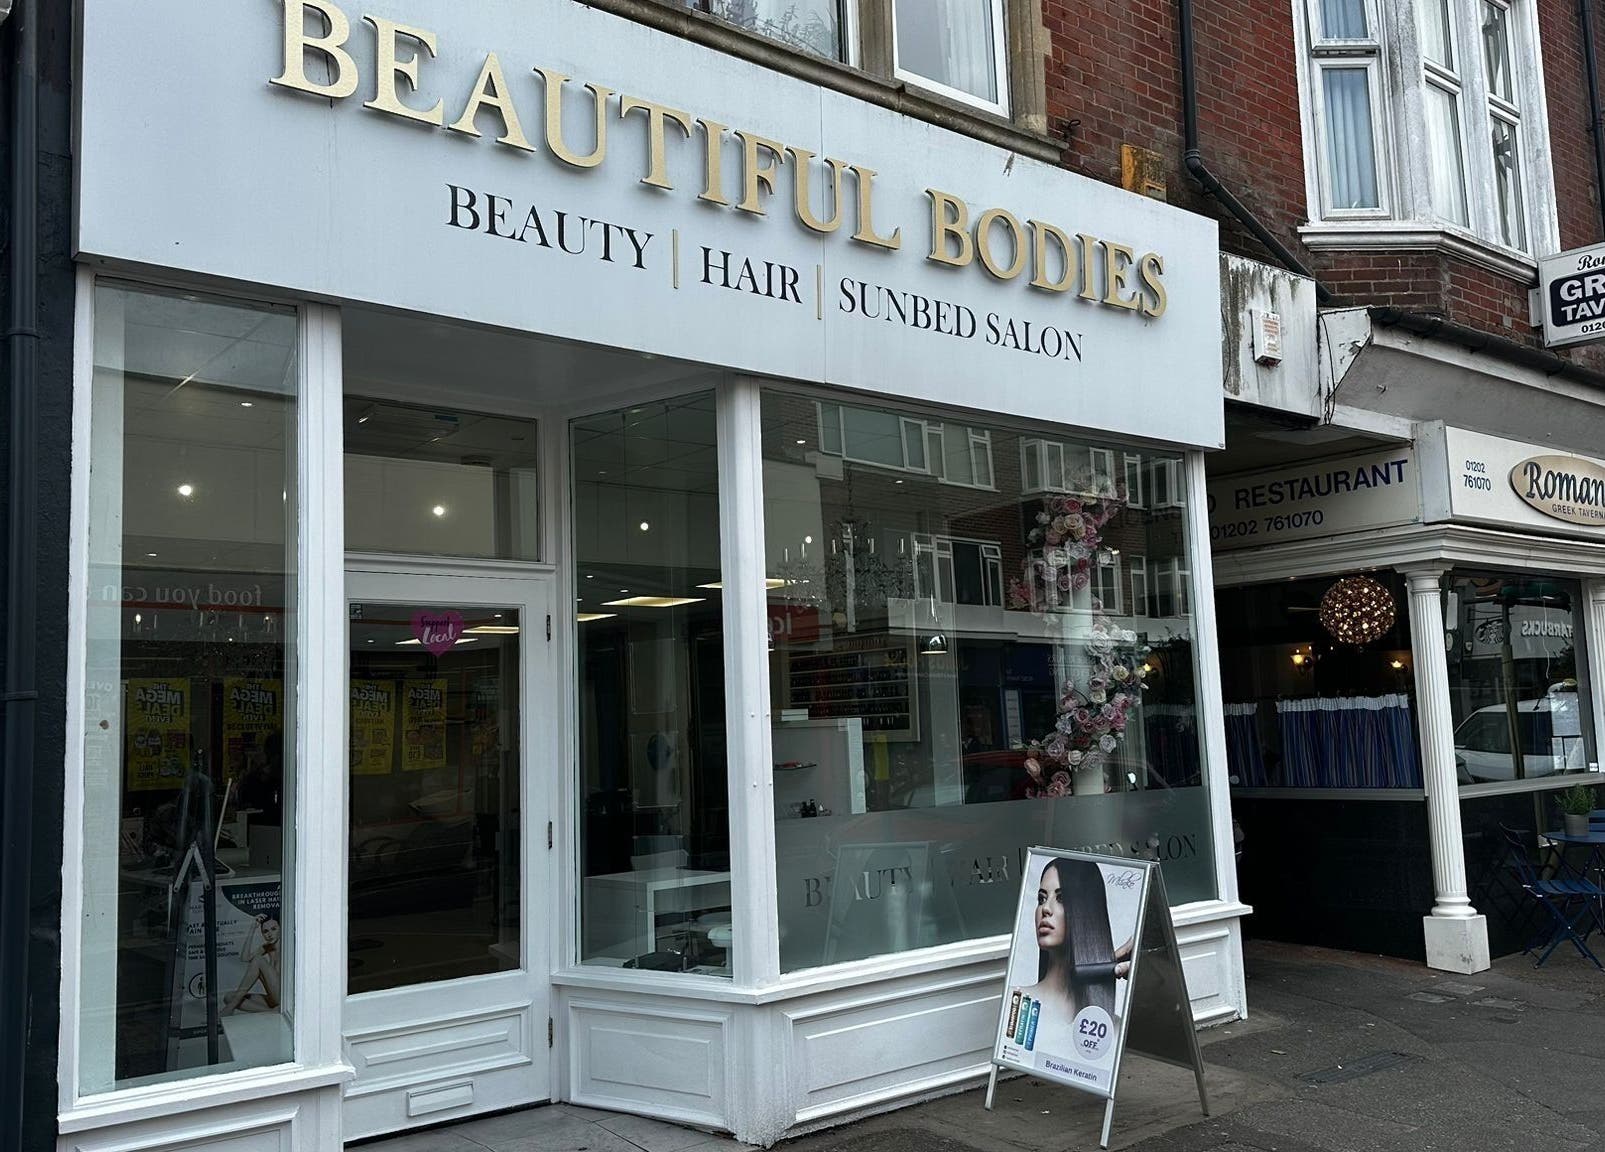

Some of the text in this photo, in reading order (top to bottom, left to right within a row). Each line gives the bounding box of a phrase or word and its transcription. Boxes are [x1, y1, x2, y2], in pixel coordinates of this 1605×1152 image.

[269, 0, 1168, 318] BEAUTIFUL BODIES
[445, 183, 1083, 363] BEAUTY HAIR SUNBED SALON
[1577, 254, 1605, 271] Ro
[1465, 460, 1486, 473] 01202
[1235, 459, 1408, 510] RESTAURANT
[1463, 474, 1491, 491] 761070
[1552, 503, 1576, 515] GREEK
[1210, 509, 1324, 541] 01202 761070
[422, 623, 457, 645] Local
[1079, 1018, 1107, 1039] £20
[1045, 1060, 1098, 1082] Brazilian Keratin
